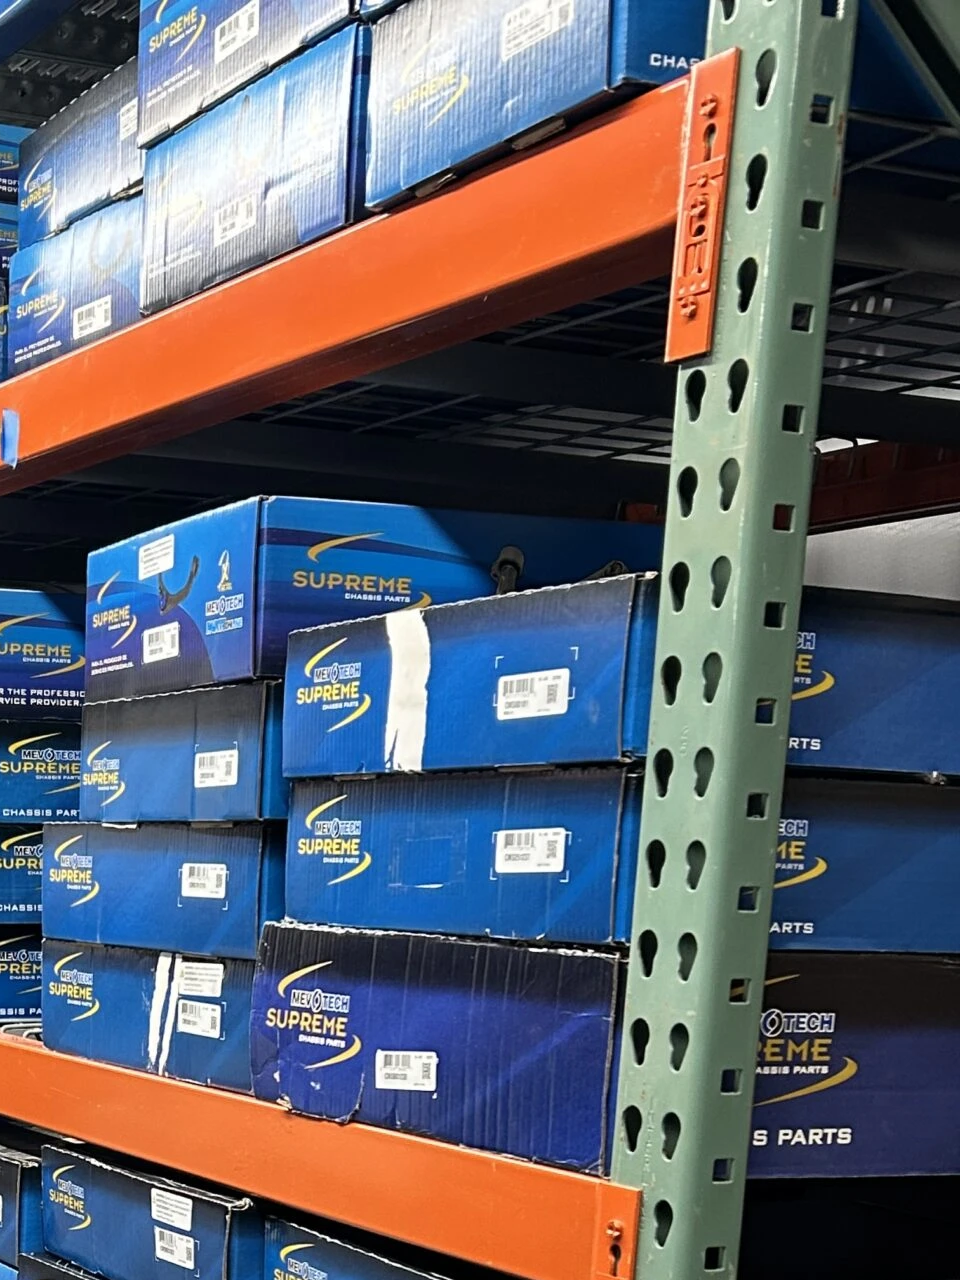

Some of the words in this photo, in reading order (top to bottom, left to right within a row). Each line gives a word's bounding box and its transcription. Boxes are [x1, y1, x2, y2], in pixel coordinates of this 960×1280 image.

[149, 6, 198, 52] SUPREME
[393, 65, 457, 113] SUPREME
[21, 182, 52, 211] SUPREME
[16, 290, 59, 318] SUPREME
[293, 570, 413, 594] SUPREME
[205, 594, 244, 617] MEVOTECH
[344, 593, 381, 601] CHASSIS
[384, 595, 411, 603] PARTS
[93, 605, 130, 629] SUPREME
[313, 662, 362, 683] MEVOTECH
[5, 688, 26, 696] THE
[297, 681, 360, 705] SUPREME
[343, 700, 359, 709] PARTS
[788, 737, 821, 750] RTS
[22, 748, 81, 762] MEVOTECH
[0, 761, 80, 774] SUPREME
[83, 770, 119, 785] SUPREME
[2, 808, 52, 817] CHASSIS
[314, 819, 362, 836] MEVOTECH
[298, 838, 360, 856] SUPREME
[49, 869, 92, 884] SUPREME
[770, 922, 814, 934] ARTS
[49, 982, 92, 1000] SUPREME
[290, 988, 350, 1013] MEVOTECH
[266, 1008, 348, 1037] SUPREME
[298, 1034, 325, 1047] CHASSIS
[326, 1038, 346, 1048] PARTS
[793, 1065, 829, 1074] PARTS
[777, 1128, 853, 1145] PARTS
[49, 1188, 84, 1212] SUPREME
